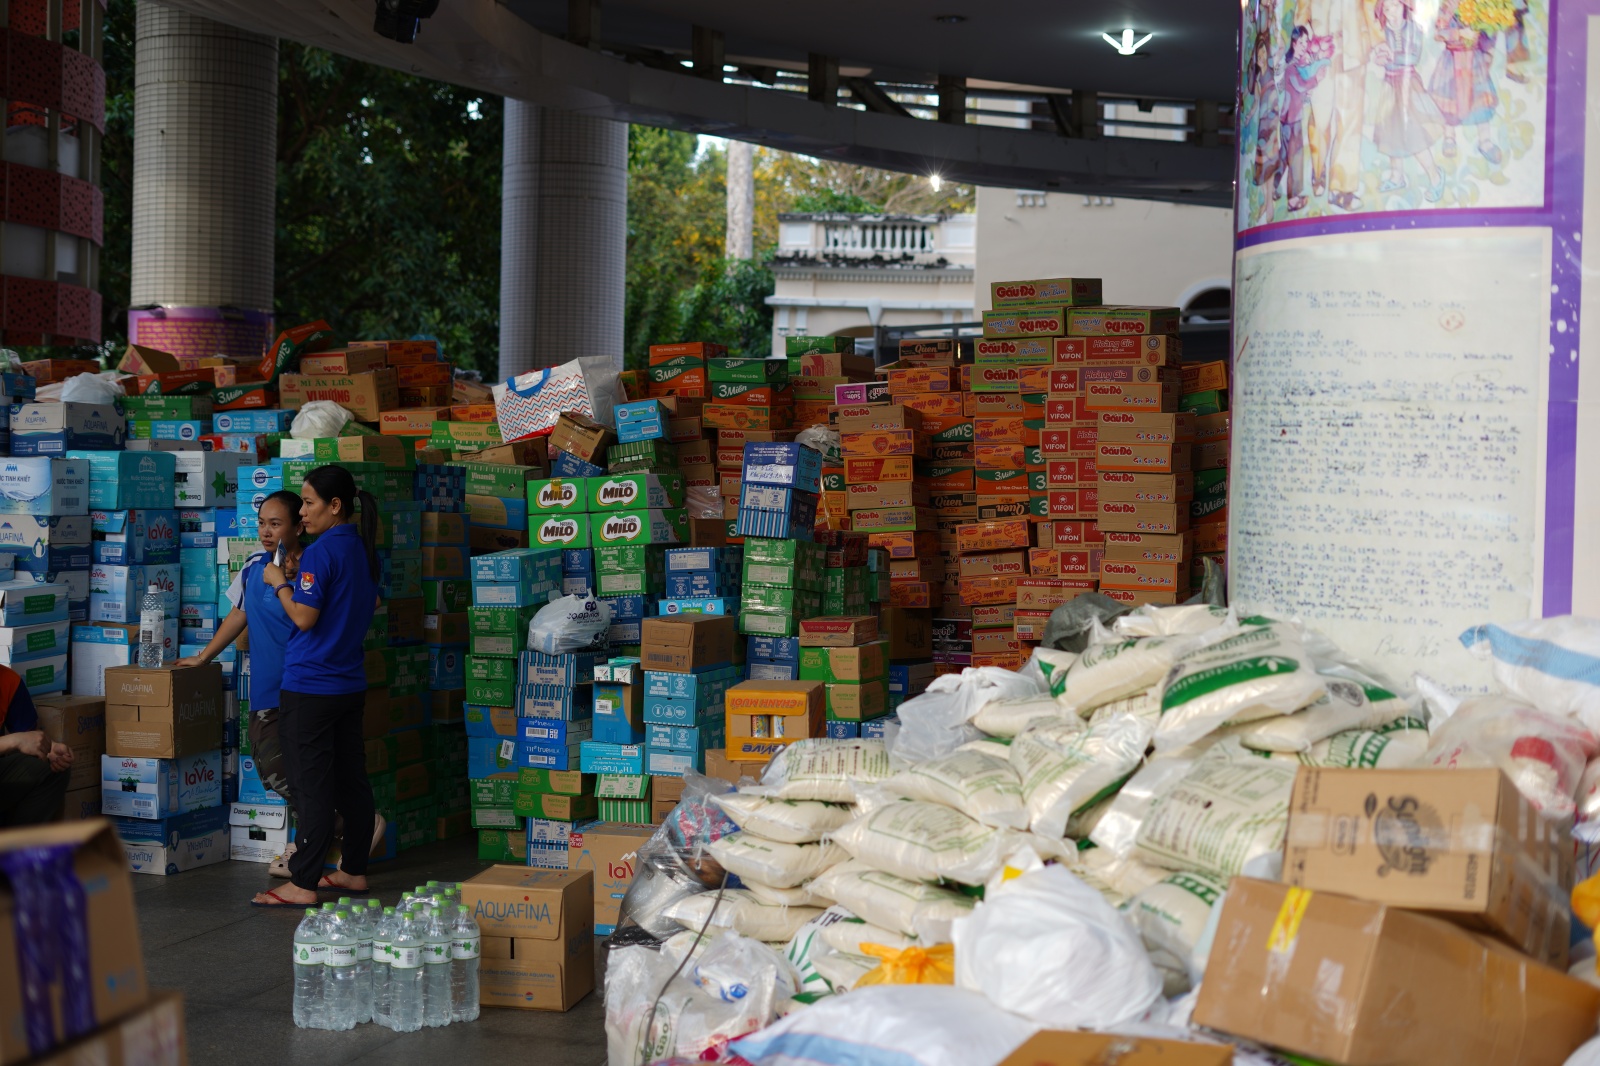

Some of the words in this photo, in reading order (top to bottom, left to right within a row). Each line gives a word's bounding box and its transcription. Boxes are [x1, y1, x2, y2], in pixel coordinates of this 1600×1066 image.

[996, 286, 1020, 298] Gấu
[1020, 285, 1036, 297] Đỏ
[1019, 320, 1034, 333] Đỏ
[1035, 319, 1058, 332] Gấu
[1105, 321, 1121, 333] Đỏ
[1121, 320, 1145, 333] Gấu
[979, 342, 1001, 354] Gấu
[1001, 342, 1016, 353] Đỏ
[1093, 339, 1120, 349] Hoàng
[1121, 339, 1135, 347] Gia
[725, 359, 745, 369] 3Miền
[655, 368, 682, 382] 3Miền
[984, 369, 1007, 381] Gấu
[1085, 370, 1113, 380] Hoàng
[1113, 369, 1127, 378] Gia
[718, 384, 748, 397] 3Miền
[1090, 386, 1109, 395] Gấu
[1110, 386, 1122, 394] Đỏ
[979, 395, 994, 403] Gấu
[995, 395, 1005, 403] Đỏ
[844, 409, 859, 417] Gấu
[1103, 413, 1121, 422] Gấu
[1122, 413, 1134, 422] Đỏ
[25, 416, 47, 424] AQUAFINA
[83, 419, 108, 431] AQUAFINA
[720, 430, 735, 439] Gấu
[942, 423, 973, 438] 3Miền
[980, 429, 993, 439] Hảo
[994, 428, 1008, 436] Hảo
[1101, 446, 1119, 455] Gấu
[1120, 446, 1132, 455] Đỏ
[995, 470, 1016, 480] 3Miền
[1103, 472, 1121, 482] Gấu
[1122, 473, 1134, 482] Đỏ
[603, 486, 633, 499] MILO
[851, 485, 867, 493] Gấu
[868, 484, 878, 492] Đỏ
[542, 489, 573, 502] MILO
[1103, 504, 1122, 513] Gấu
[1123, 503, 1135, 512] Đỏ
[148, 523, 173, 540] laVie
[544, 525, 574, 537] MILO
[607, 522, 638, 535] MILO
[1003, 563, 1020, 571] Gấu
[181, 607, 199, 615] laVie
[121, 683, 154, 694] AQUAFINA
[178, 697, 217, 723] AQUAFINA
[121, 761, 138, 769] laVie
[185, 766, 215, 785] laVie
[187, 836, 213, 853] AQUAFINA
[474, 899, 552, 925] AQUAFINA
